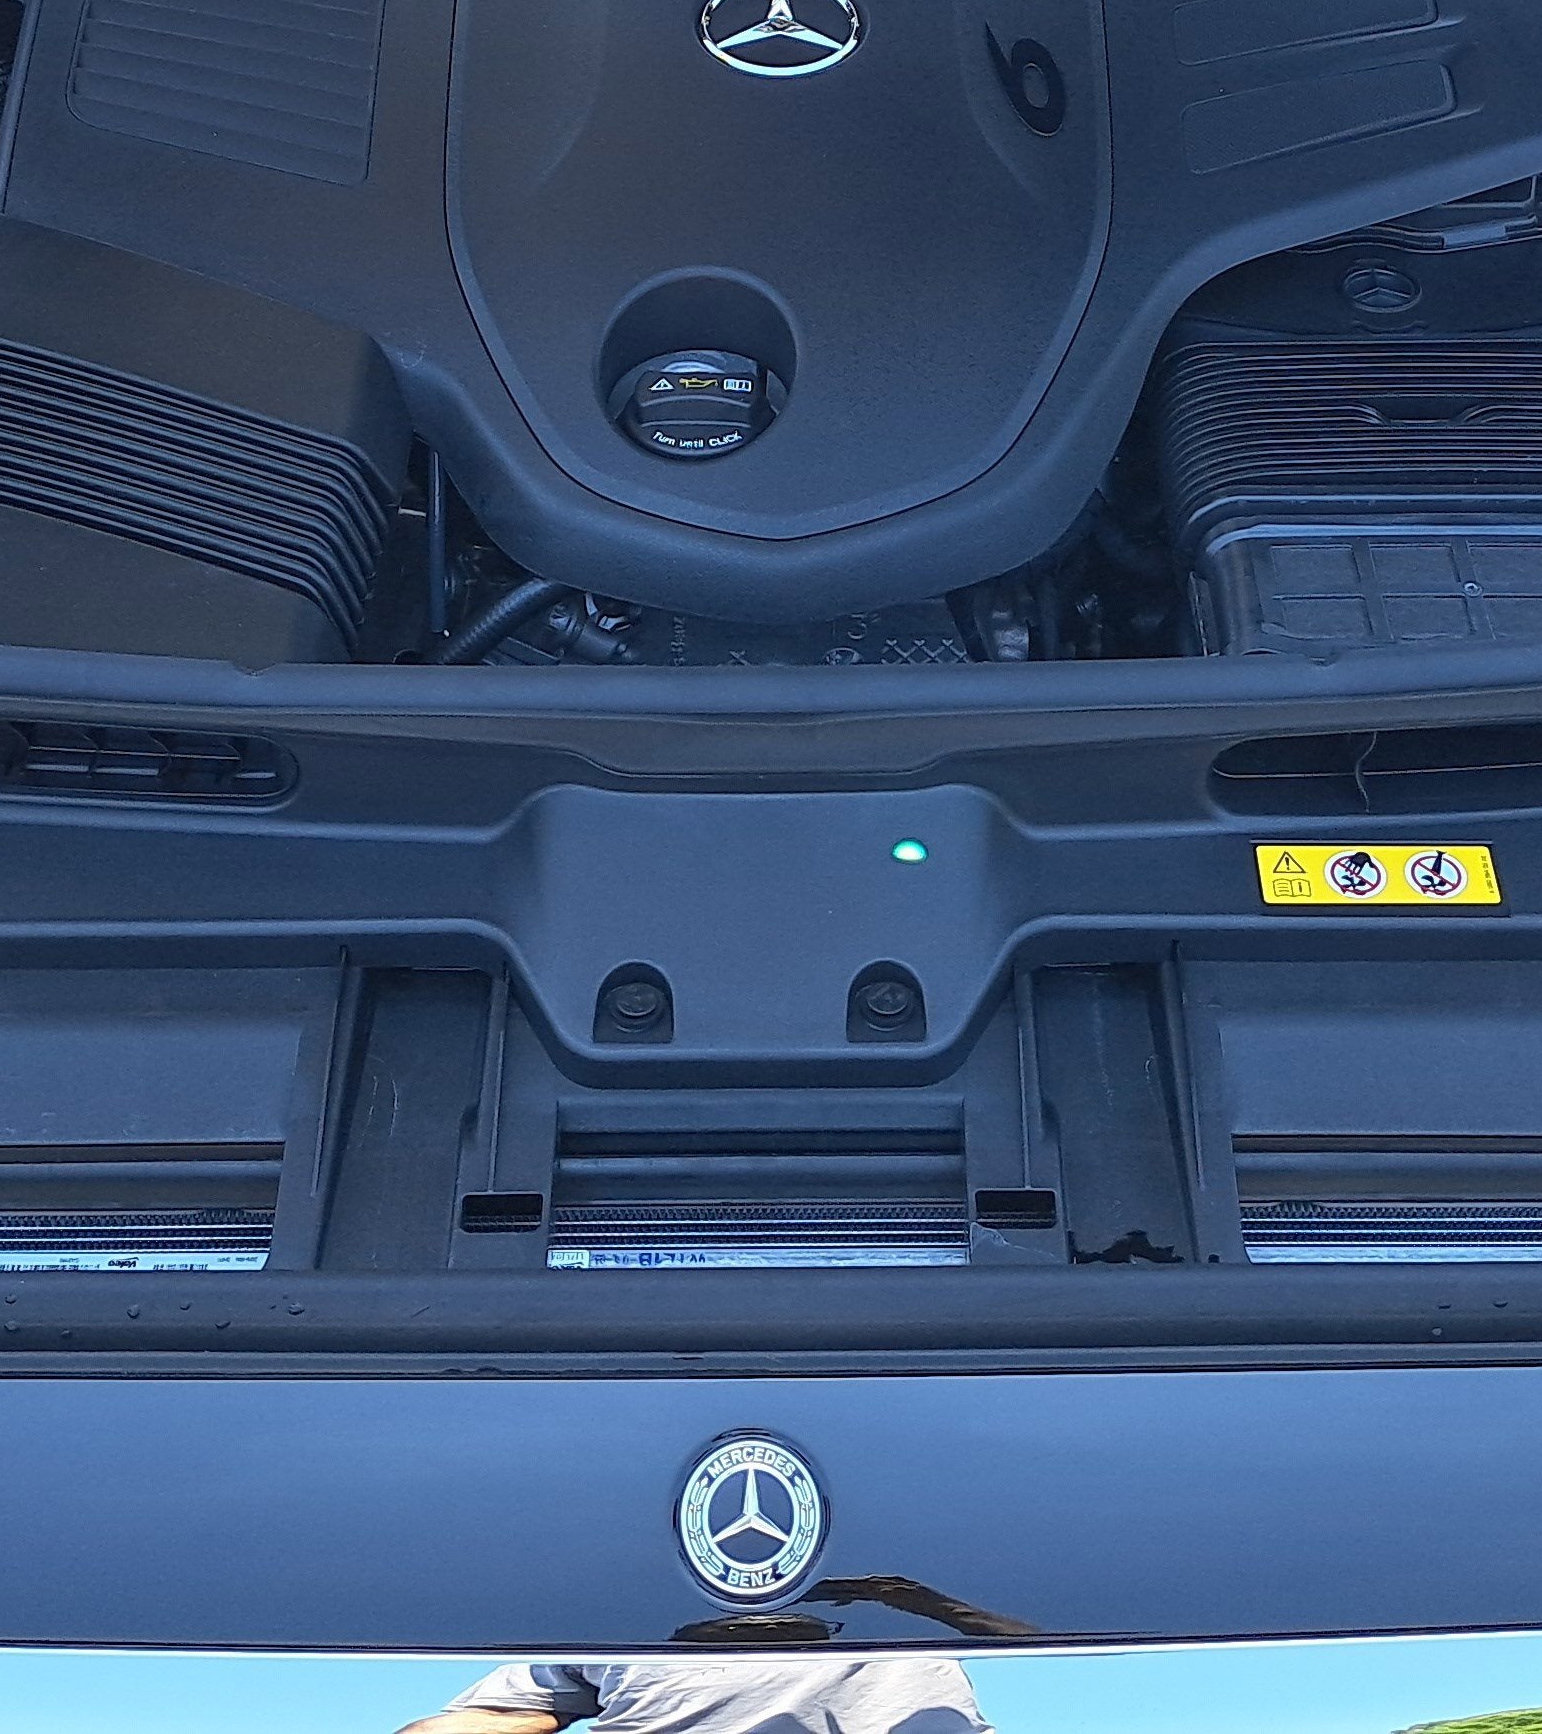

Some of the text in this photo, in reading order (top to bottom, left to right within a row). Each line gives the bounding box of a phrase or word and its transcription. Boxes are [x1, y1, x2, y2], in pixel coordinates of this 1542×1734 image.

[985, 21, 1067, 137] 6
[652, 431, 675, 446] Turn
[708, 430, 743, 447] CLICK
[707, 1447, 796, 1478] MERCEDES
[727, 1567, 776, 1587] BENZ
